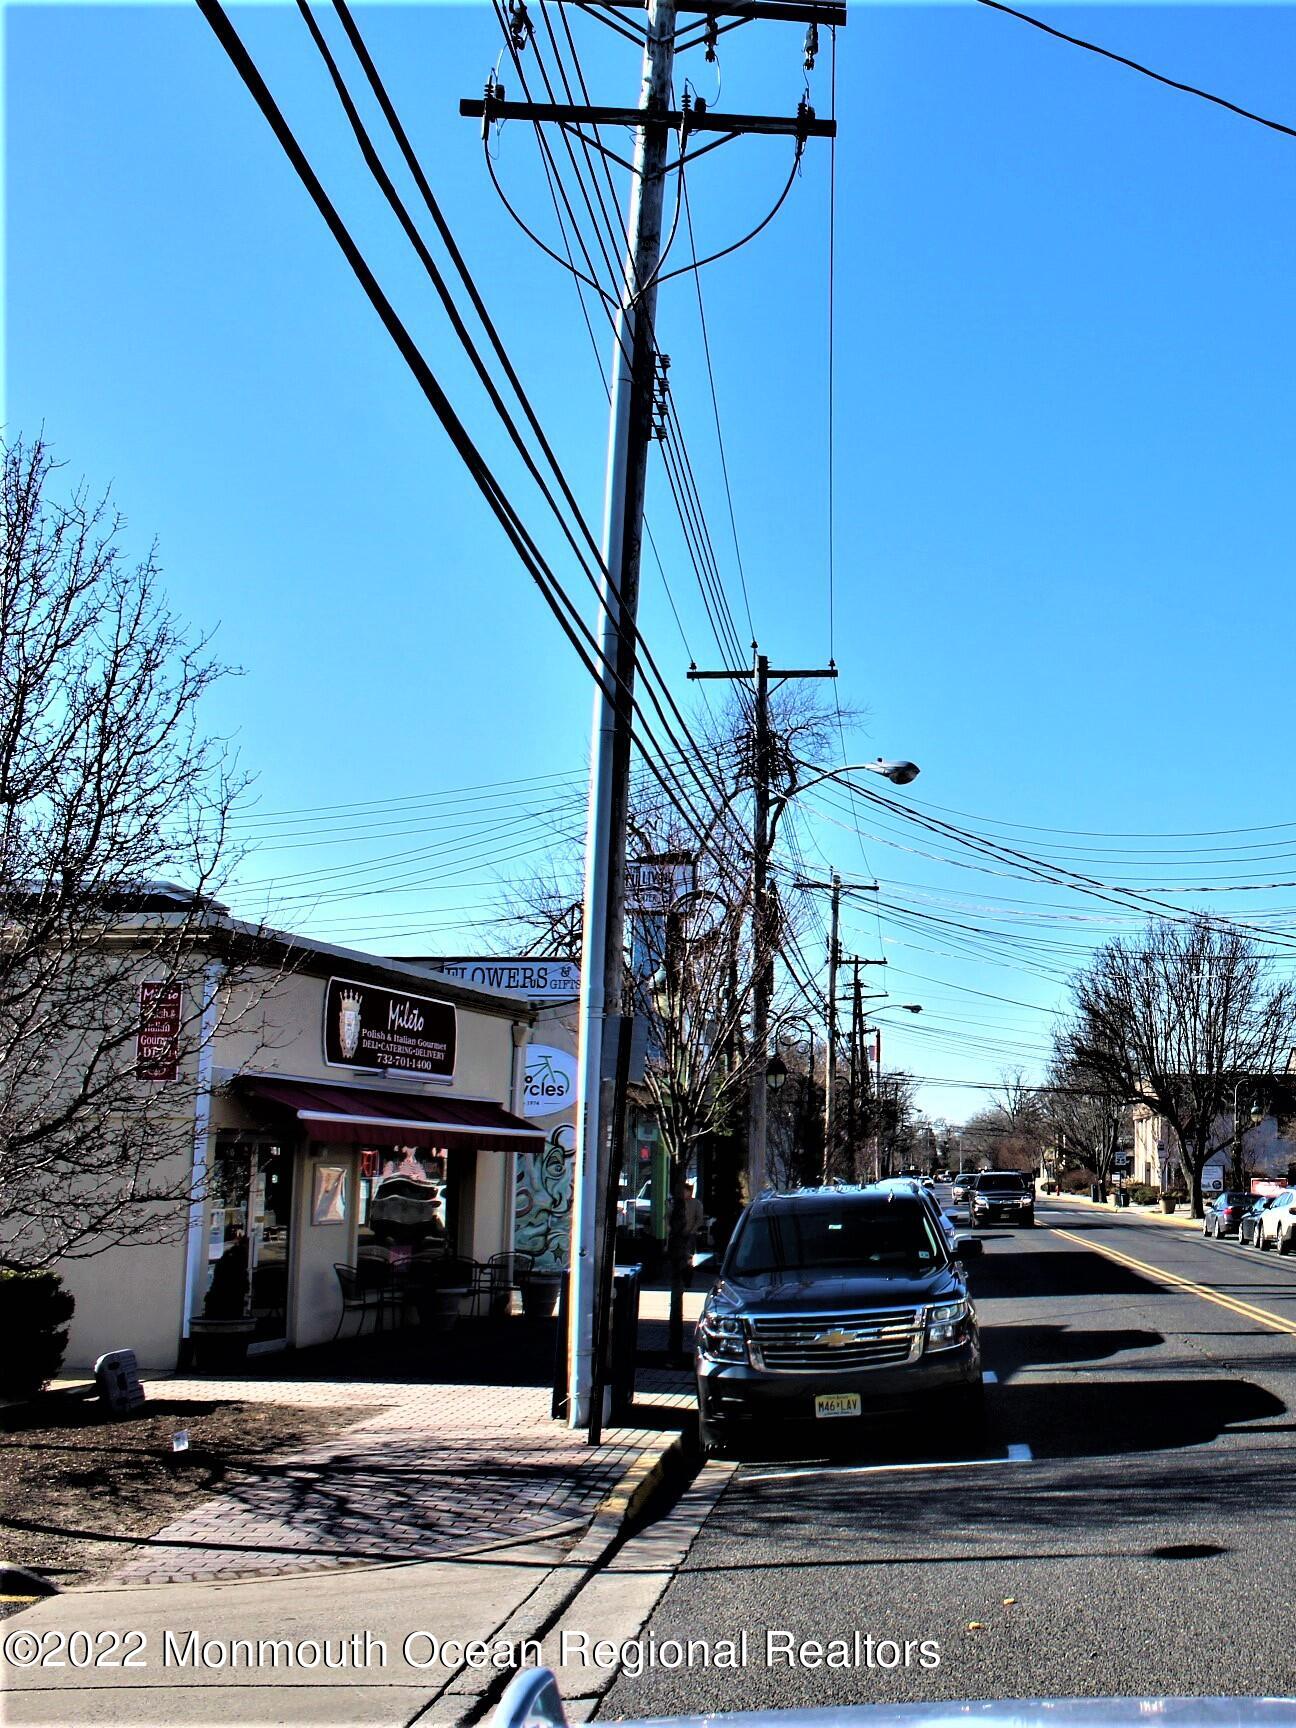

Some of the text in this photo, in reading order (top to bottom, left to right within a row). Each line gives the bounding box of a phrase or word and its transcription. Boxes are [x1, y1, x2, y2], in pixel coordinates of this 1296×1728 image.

[387, 999, 425, 1032] Mileto
[361, 1028, 448, 1050] Polish & Italian Gourmet
[376, 1053, 433, 1070] 732-701-1400
